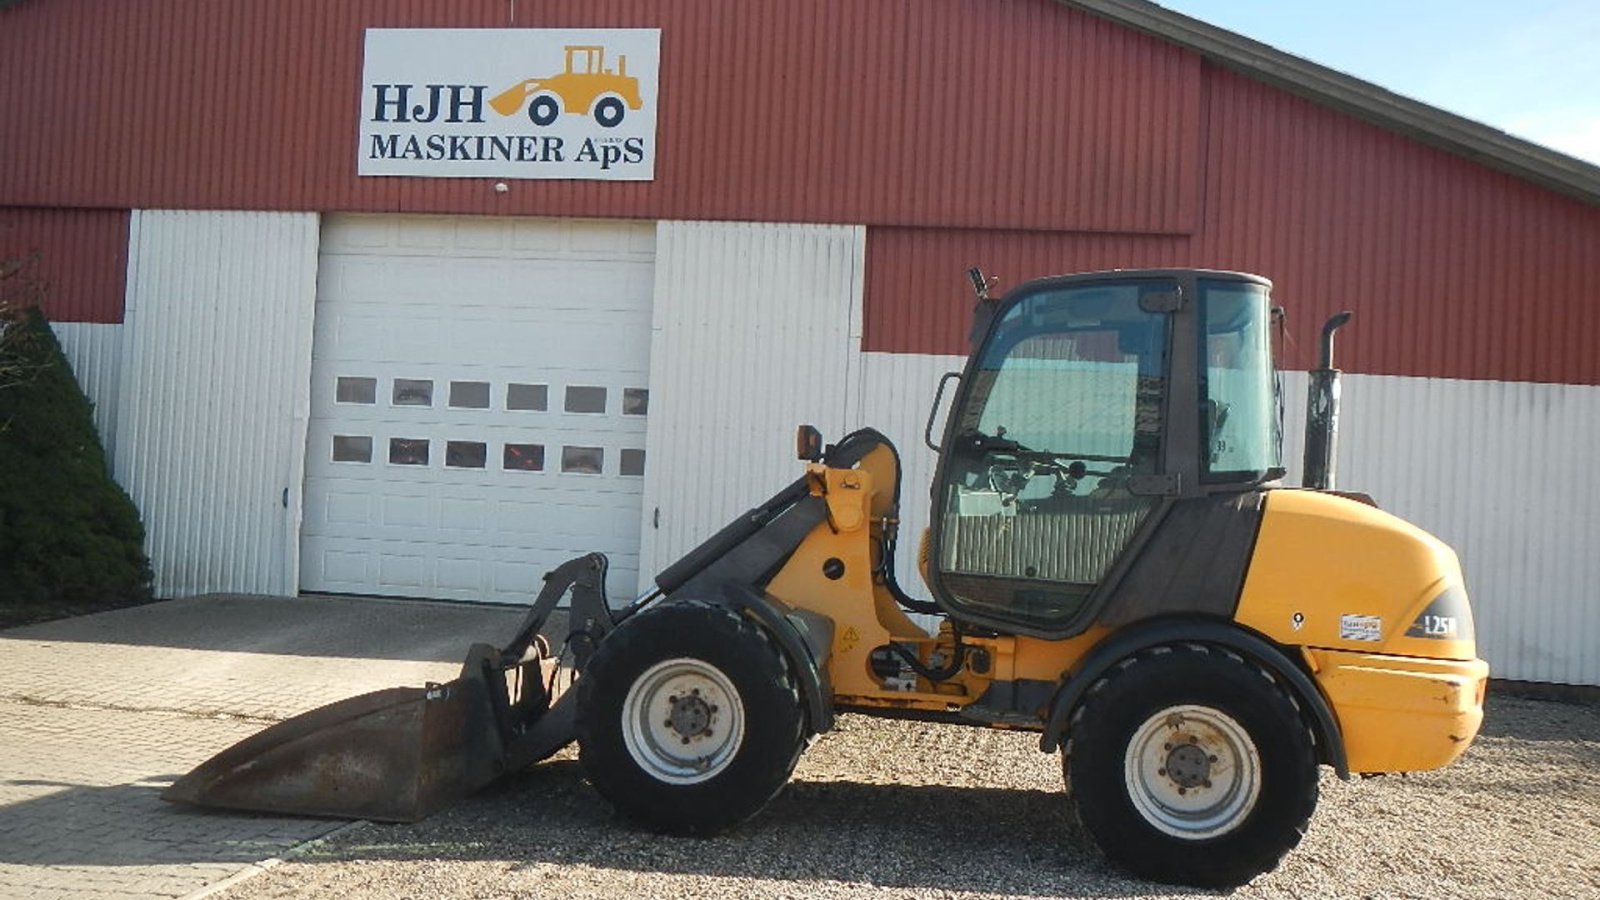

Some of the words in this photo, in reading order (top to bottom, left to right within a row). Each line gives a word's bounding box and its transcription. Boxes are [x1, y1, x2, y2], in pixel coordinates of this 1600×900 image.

[371, 84, 488, 123] HJH
[369, 134, 565, 163] MASKINER
[574, 137, 644, 170] ApS
